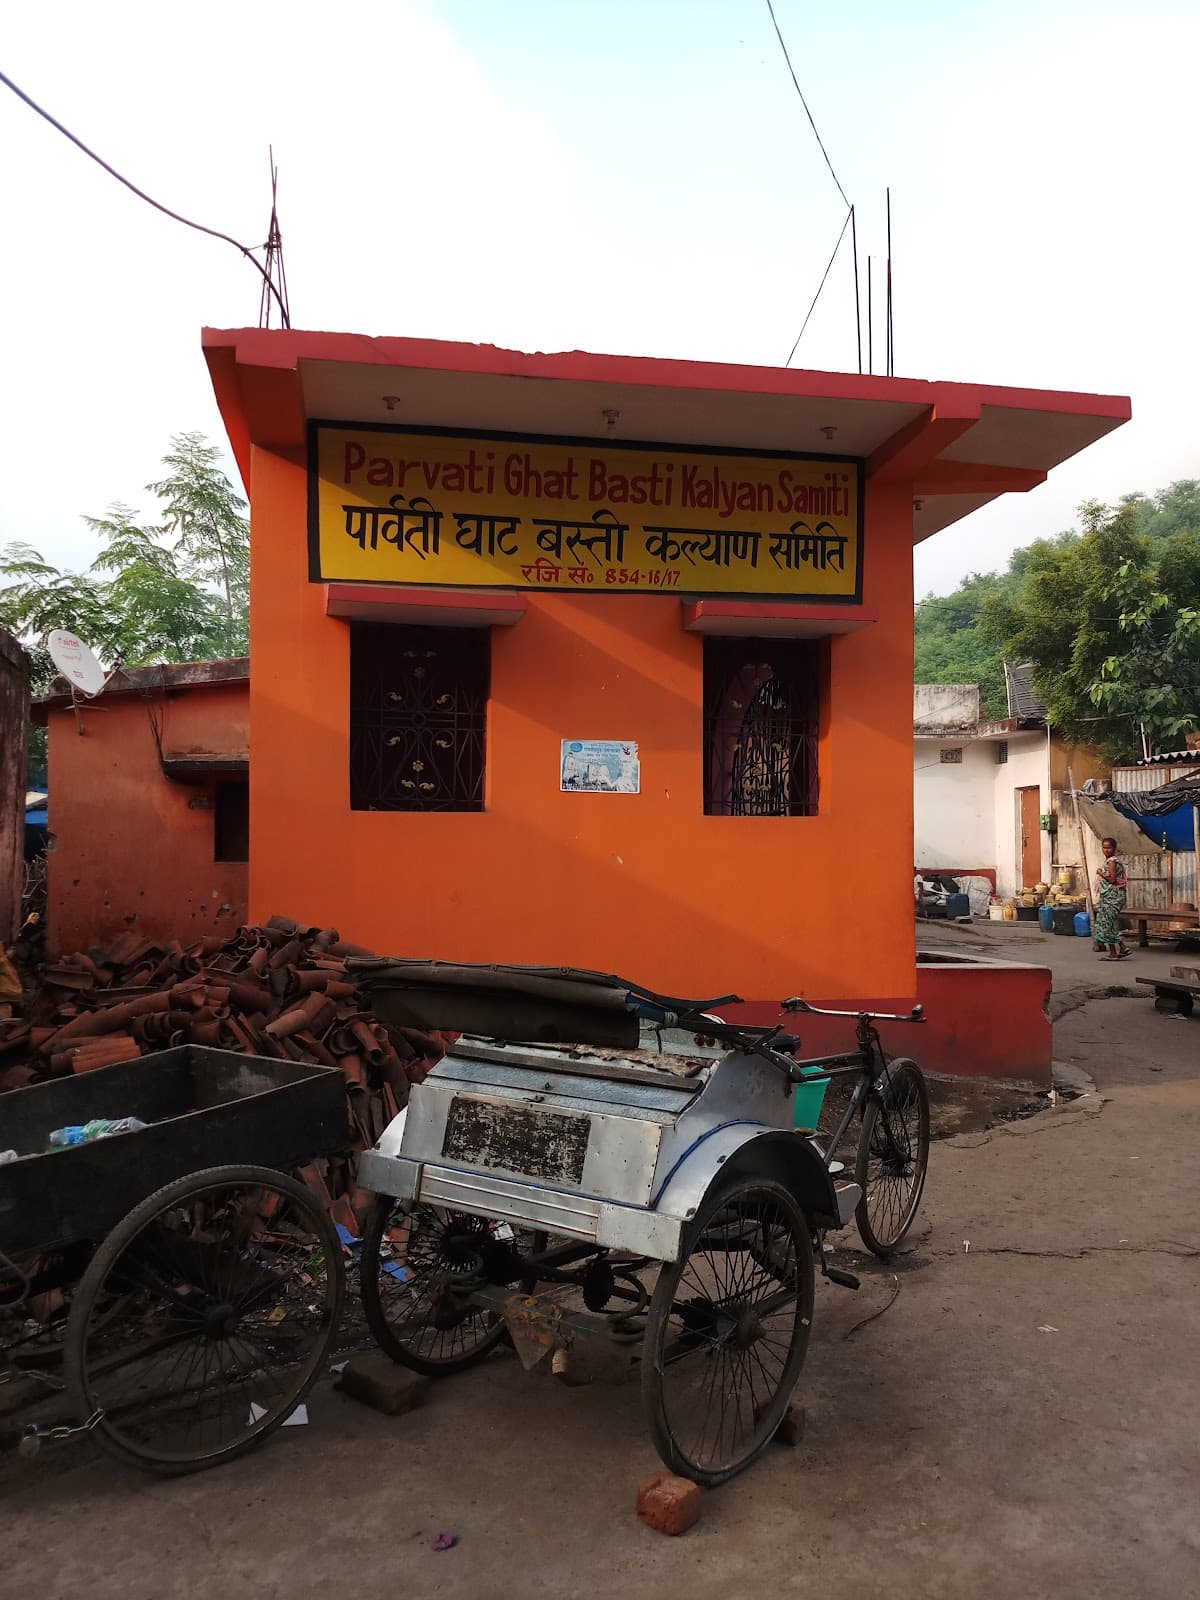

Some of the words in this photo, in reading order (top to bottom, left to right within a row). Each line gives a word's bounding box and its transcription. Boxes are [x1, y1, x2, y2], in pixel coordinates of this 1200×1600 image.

[344, 441, 495, 494] Parvati
[504, 453, 579, 501] Ghat
[589, 459, 675, 506] Basti
[682, 464, 773, 518] Kalyan
[778, 470, 849, 517] Samiti
[342, 494, 443, 560] पार्वती
[452, 512, 521, 556] घाट
[532, 509, 629, 566] बस्ती
[643, 526, 762, 569] कल्याण
[769, 521, 848, 574] समिति
[605, 567, 681, 588] 854-16/17
